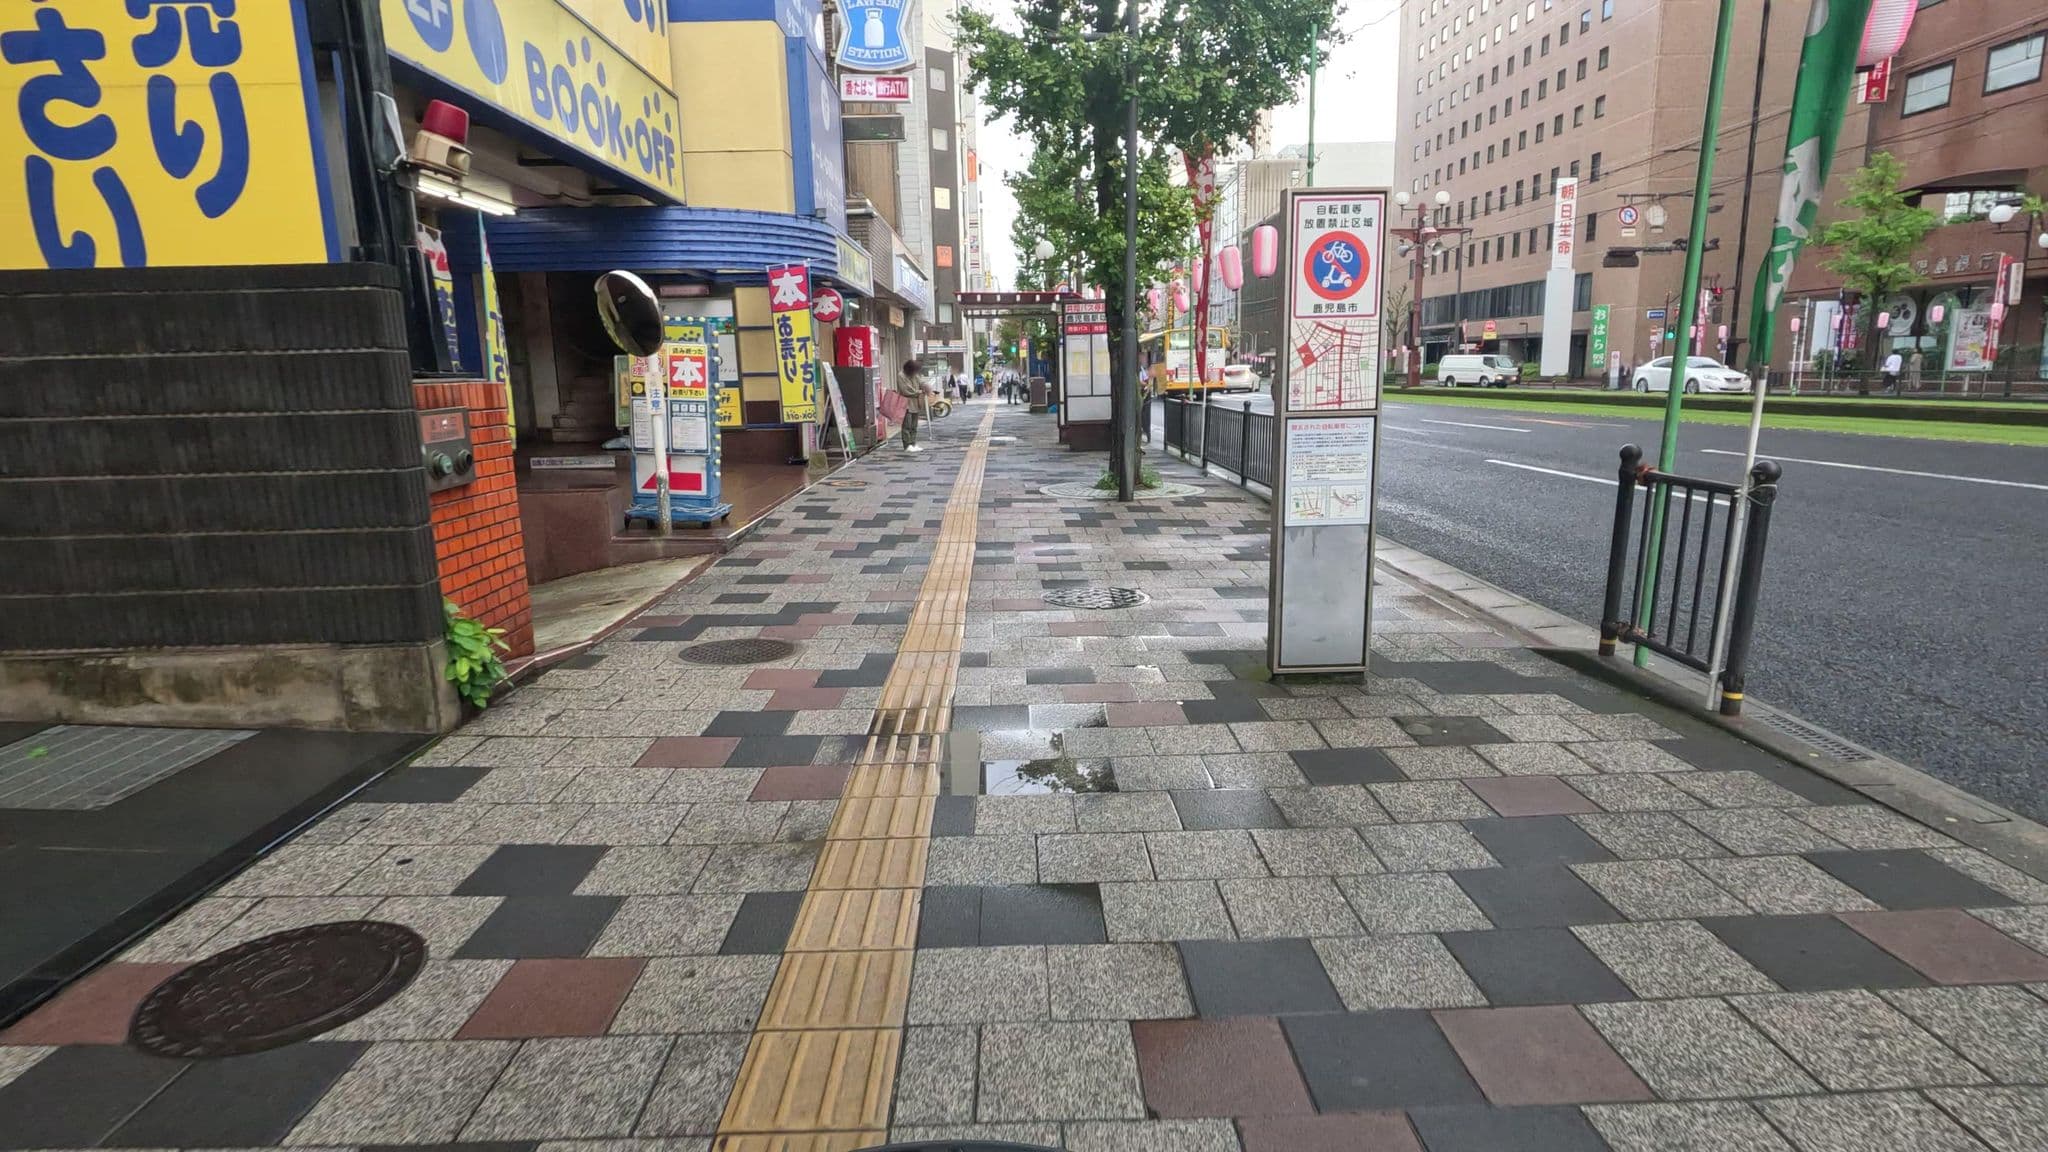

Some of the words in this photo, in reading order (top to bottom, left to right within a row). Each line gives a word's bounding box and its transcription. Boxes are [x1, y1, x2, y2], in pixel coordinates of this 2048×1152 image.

[848, 47, 902, 59] STATION
[1317, 204, 1362, 215] 自転車等
[1304, 217, 1373, 229] 放置禁止区域
[1558, 184, 1574, 254] 朝日生命
[772, 271, 807, 307] 本
[813, 294, 840, 316] 本
[1313, 303, 1358, 314] 鹿児島市
[672, 357, 704, 387] 本
